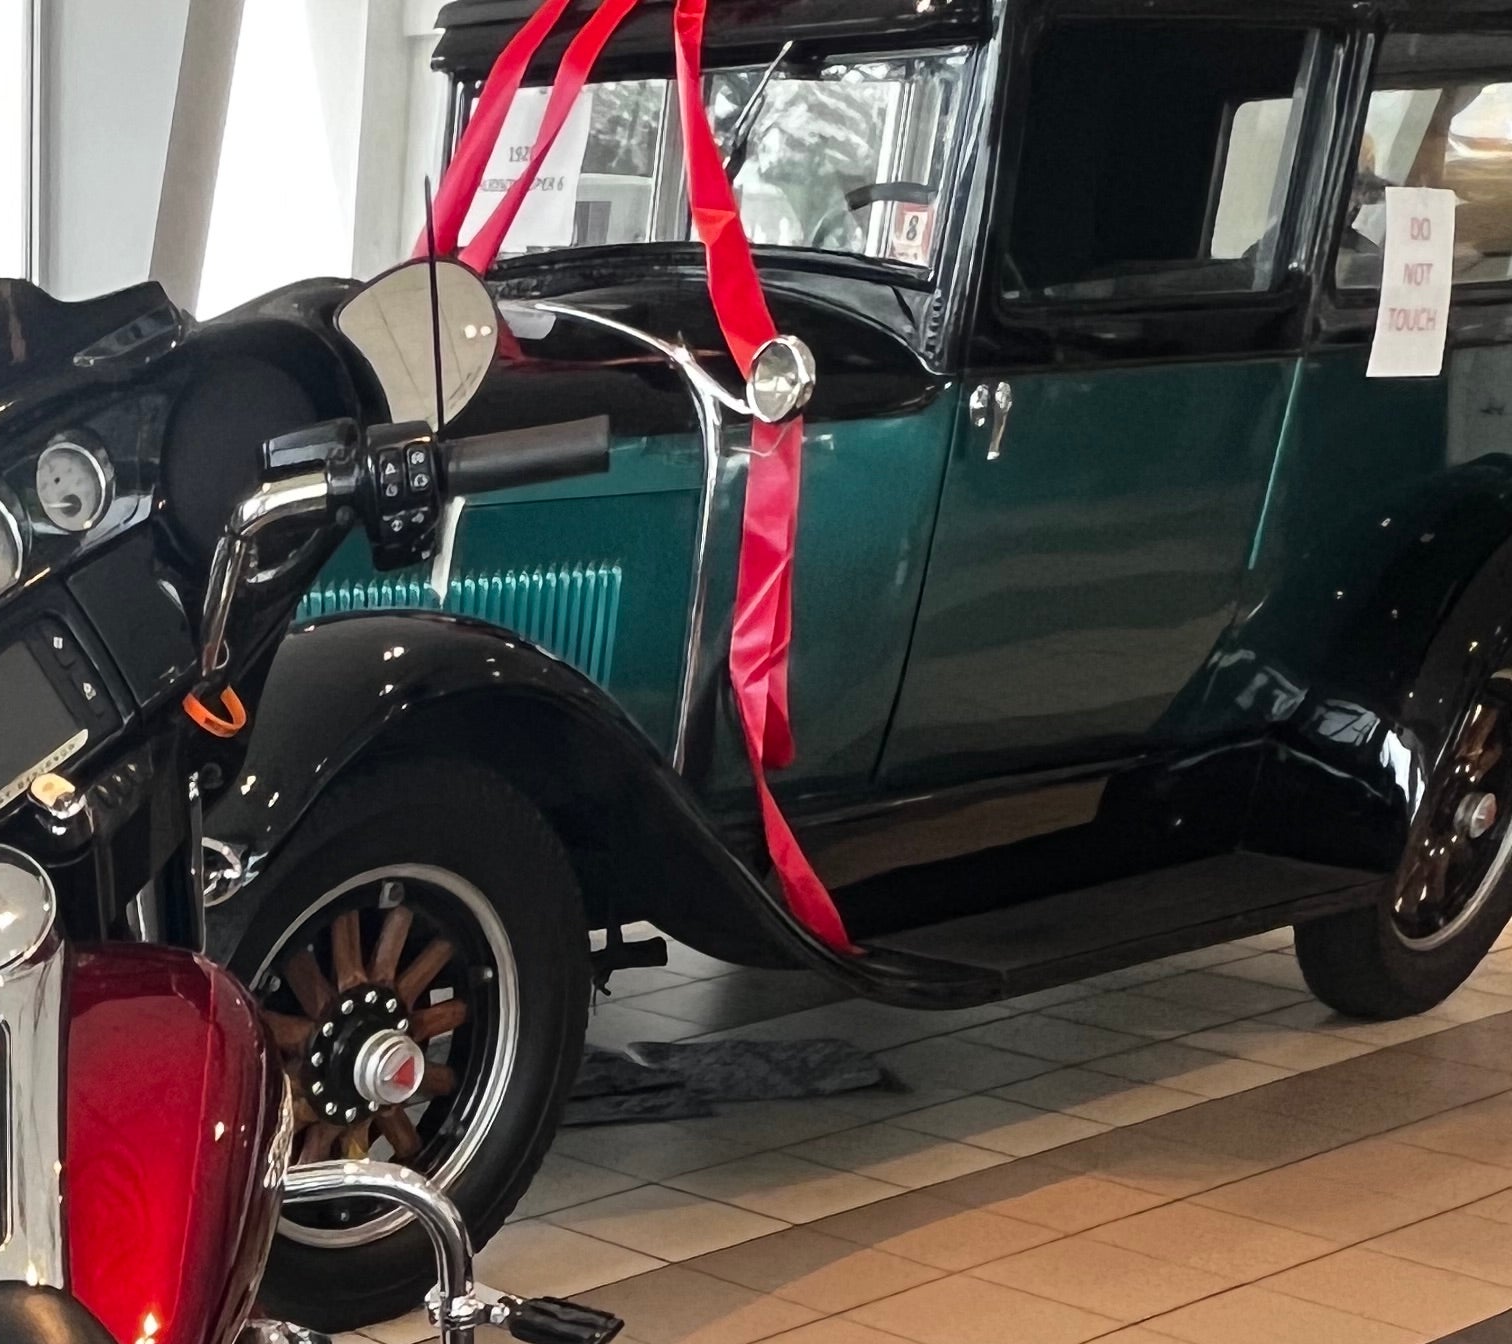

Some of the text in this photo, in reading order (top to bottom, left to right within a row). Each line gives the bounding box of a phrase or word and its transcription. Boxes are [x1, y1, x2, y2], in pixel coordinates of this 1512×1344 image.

[1409, 217, 1431, 241] DO
[1403, 263, 1434, 286] NOT
[1388, 307, 1438, 332] TOUCH
